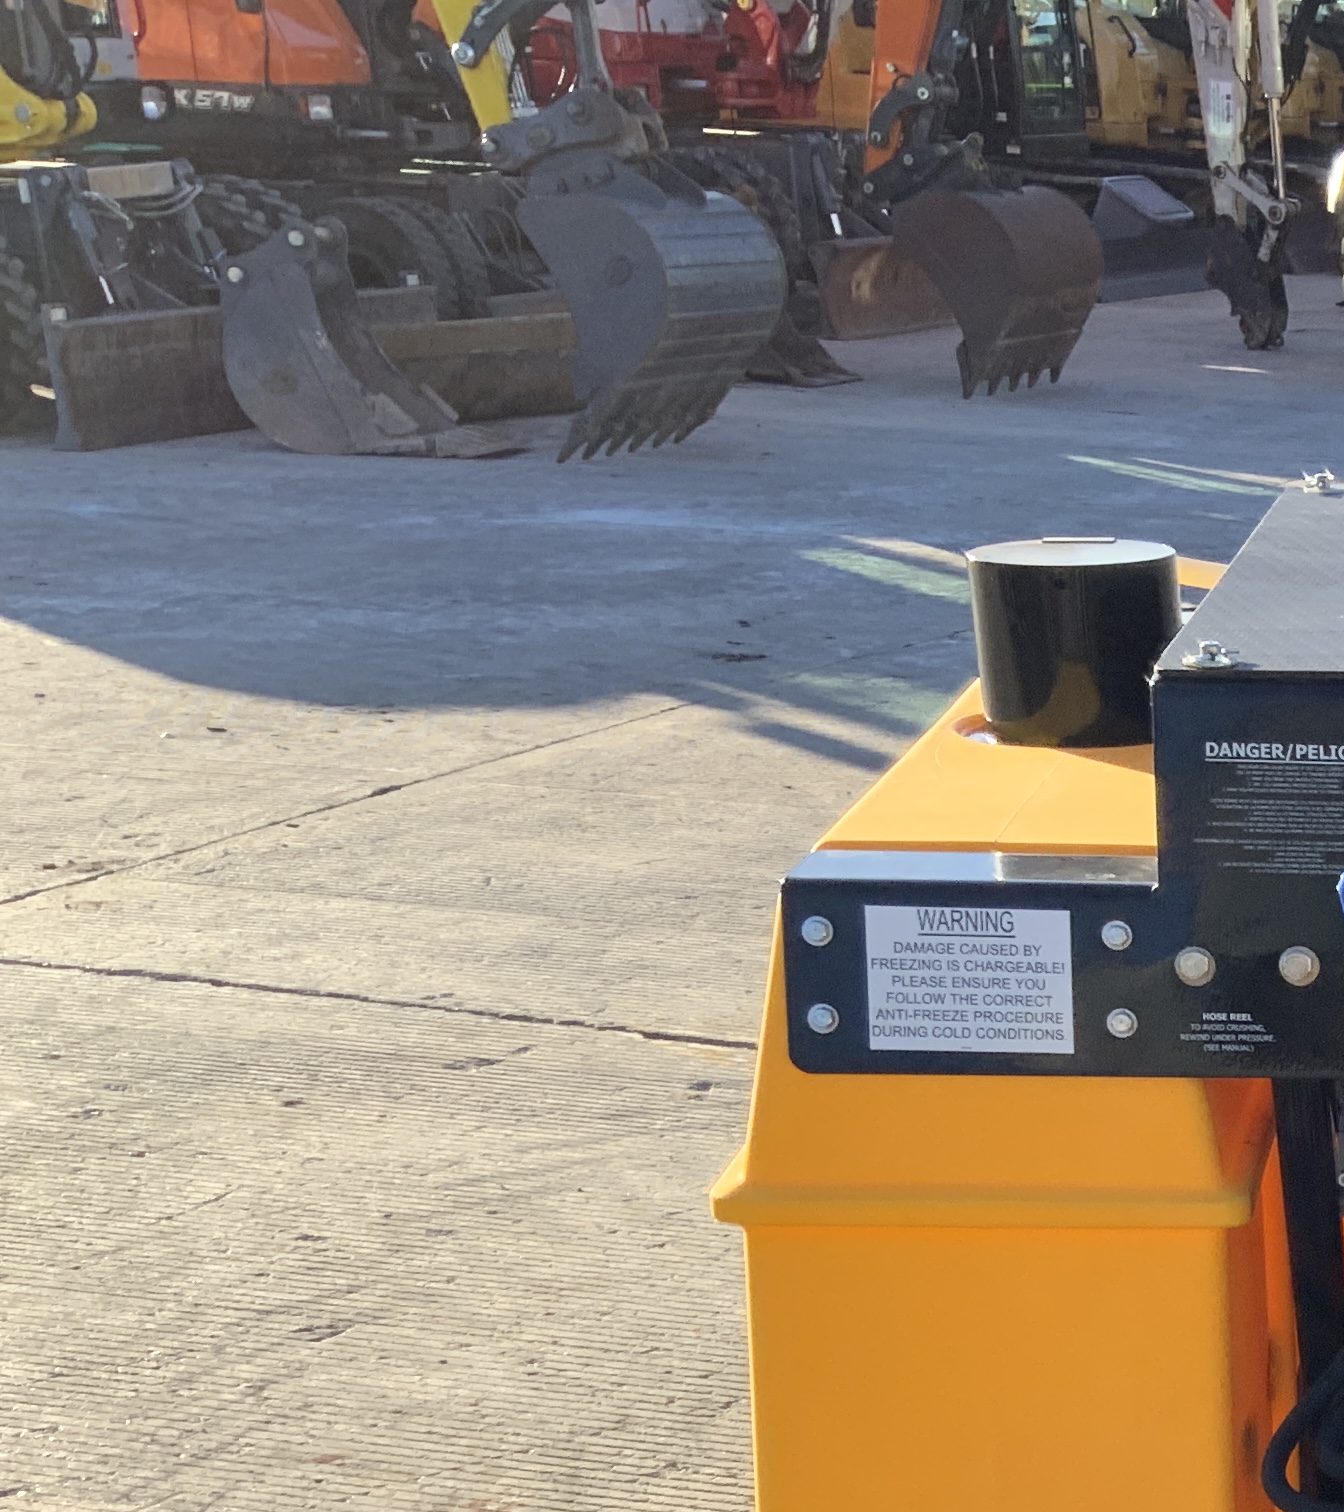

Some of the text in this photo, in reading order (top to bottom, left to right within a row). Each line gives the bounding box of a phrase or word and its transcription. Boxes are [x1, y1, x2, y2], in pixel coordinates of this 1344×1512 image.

[917, 909, 1015, 933] WARNING
[893, 941, 1042, 957] DAMAGE CAUSED BY
[870, 958, 1065, 974] FREEZING IS CHARGEABLE!
[891, 975, 1046, 991] PLEASE ENSURE YOU
[886, 992, 1053, 1008] FOLLOW THE CORRECT
[875, 1009, 1064, 1025] ANTI-FREEZE PROCEDURE
[1202, 1012, 1253, 1021] HOSE REEL
[871, 1025, 1065, 1041] DURING COLD CONDITIONS
